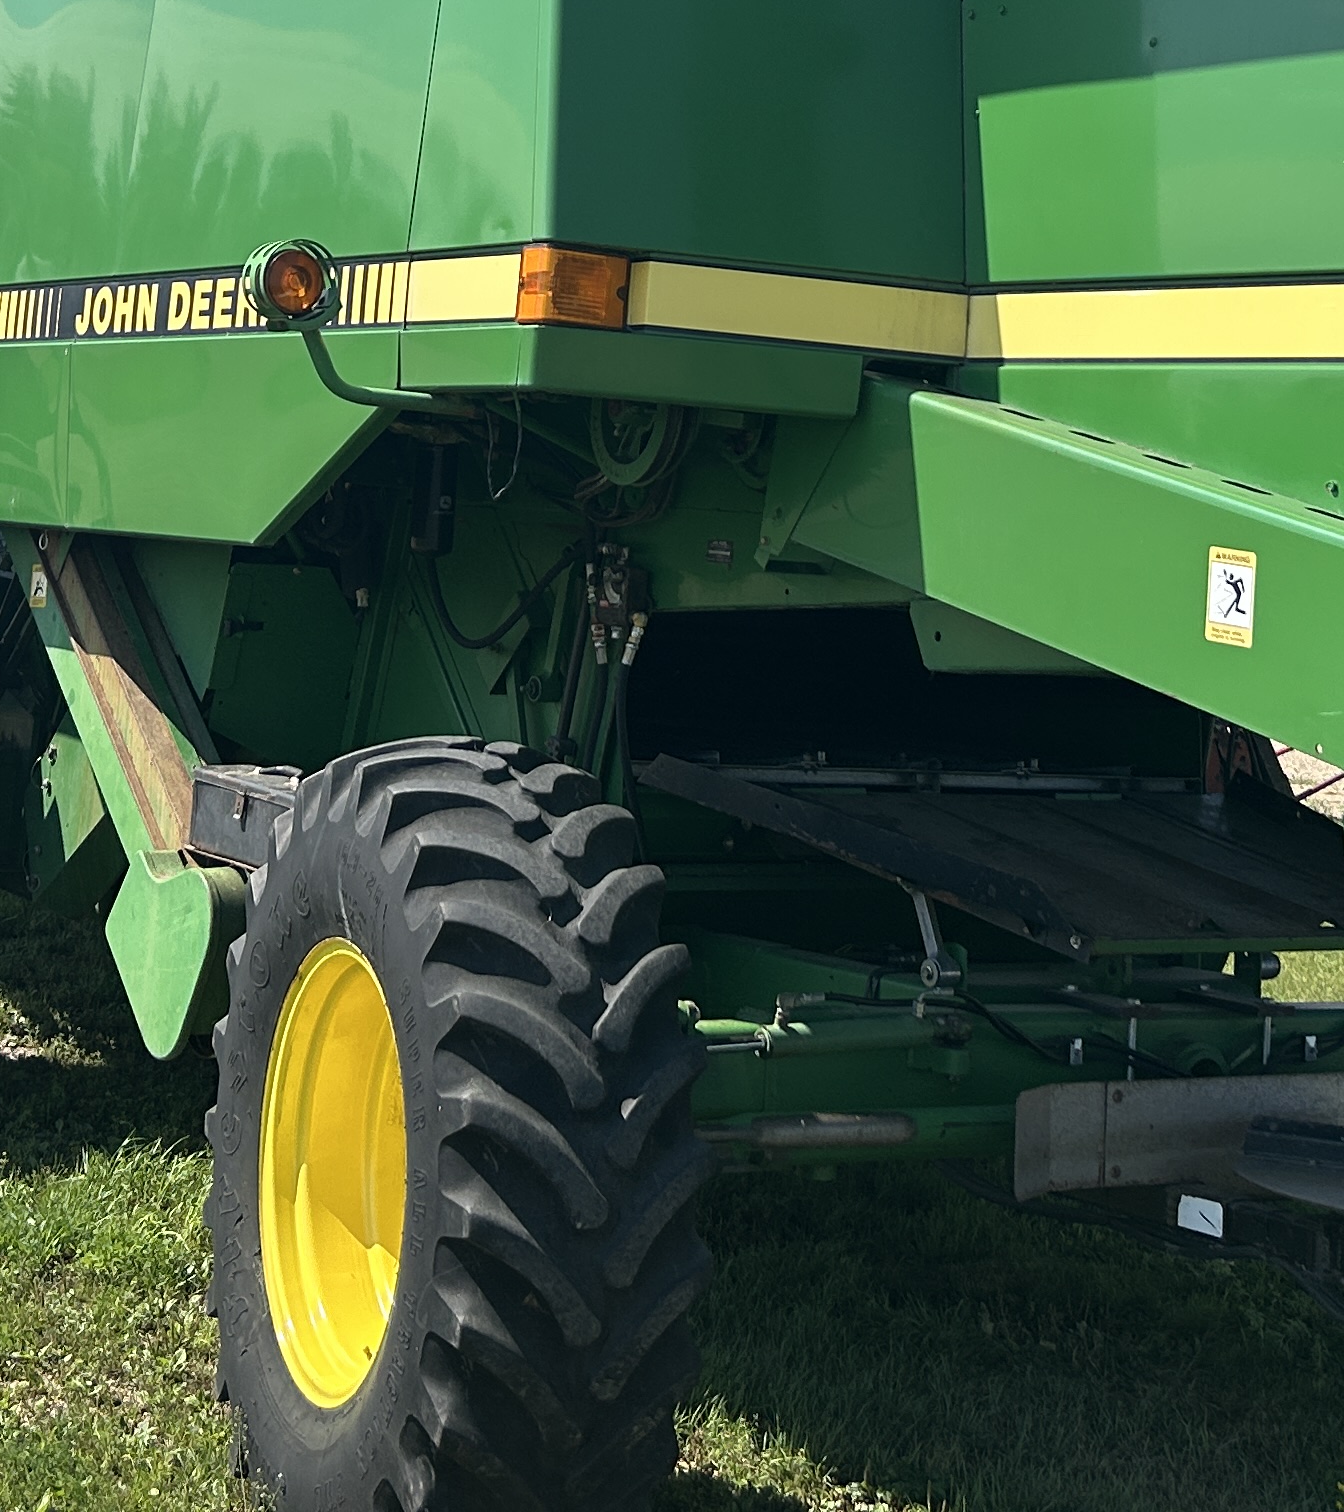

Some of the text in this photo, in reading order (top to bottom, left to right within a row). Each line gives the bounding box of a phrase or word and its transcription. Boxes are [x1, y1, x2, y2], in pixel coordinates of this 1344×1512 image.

[75, 277, 268, 336] JOHN DEER
[398, 977, 426, 1134] SUPER
[410, 1168, 428, 1257] ALL
